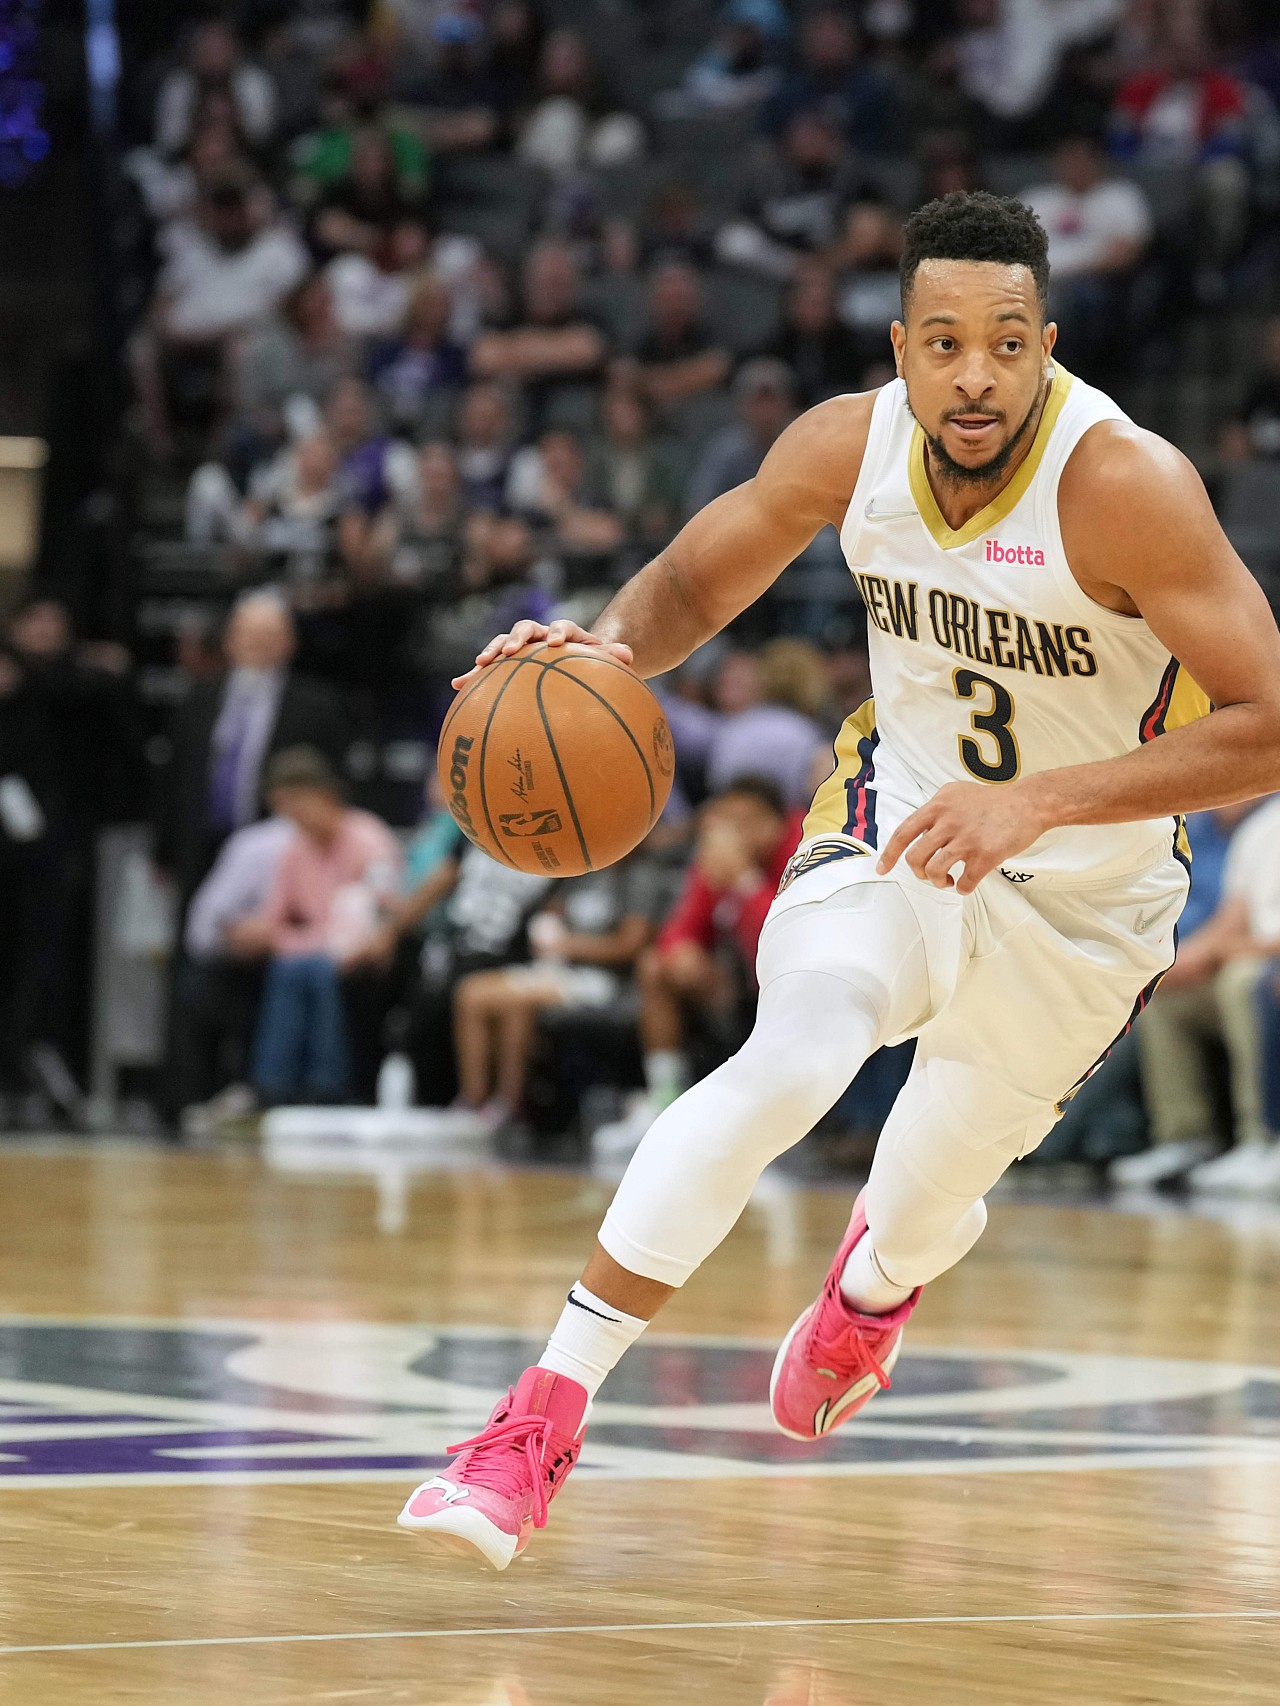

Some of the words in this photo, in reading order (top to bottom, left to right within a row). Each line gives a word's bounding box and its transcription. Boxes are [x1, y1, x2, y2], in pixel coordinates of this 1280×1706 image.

[986, 540, 1045, 566] ibotta
[928, 587, 1099, 678] ORLEANS
[952, 666, 1021, 785] 3
